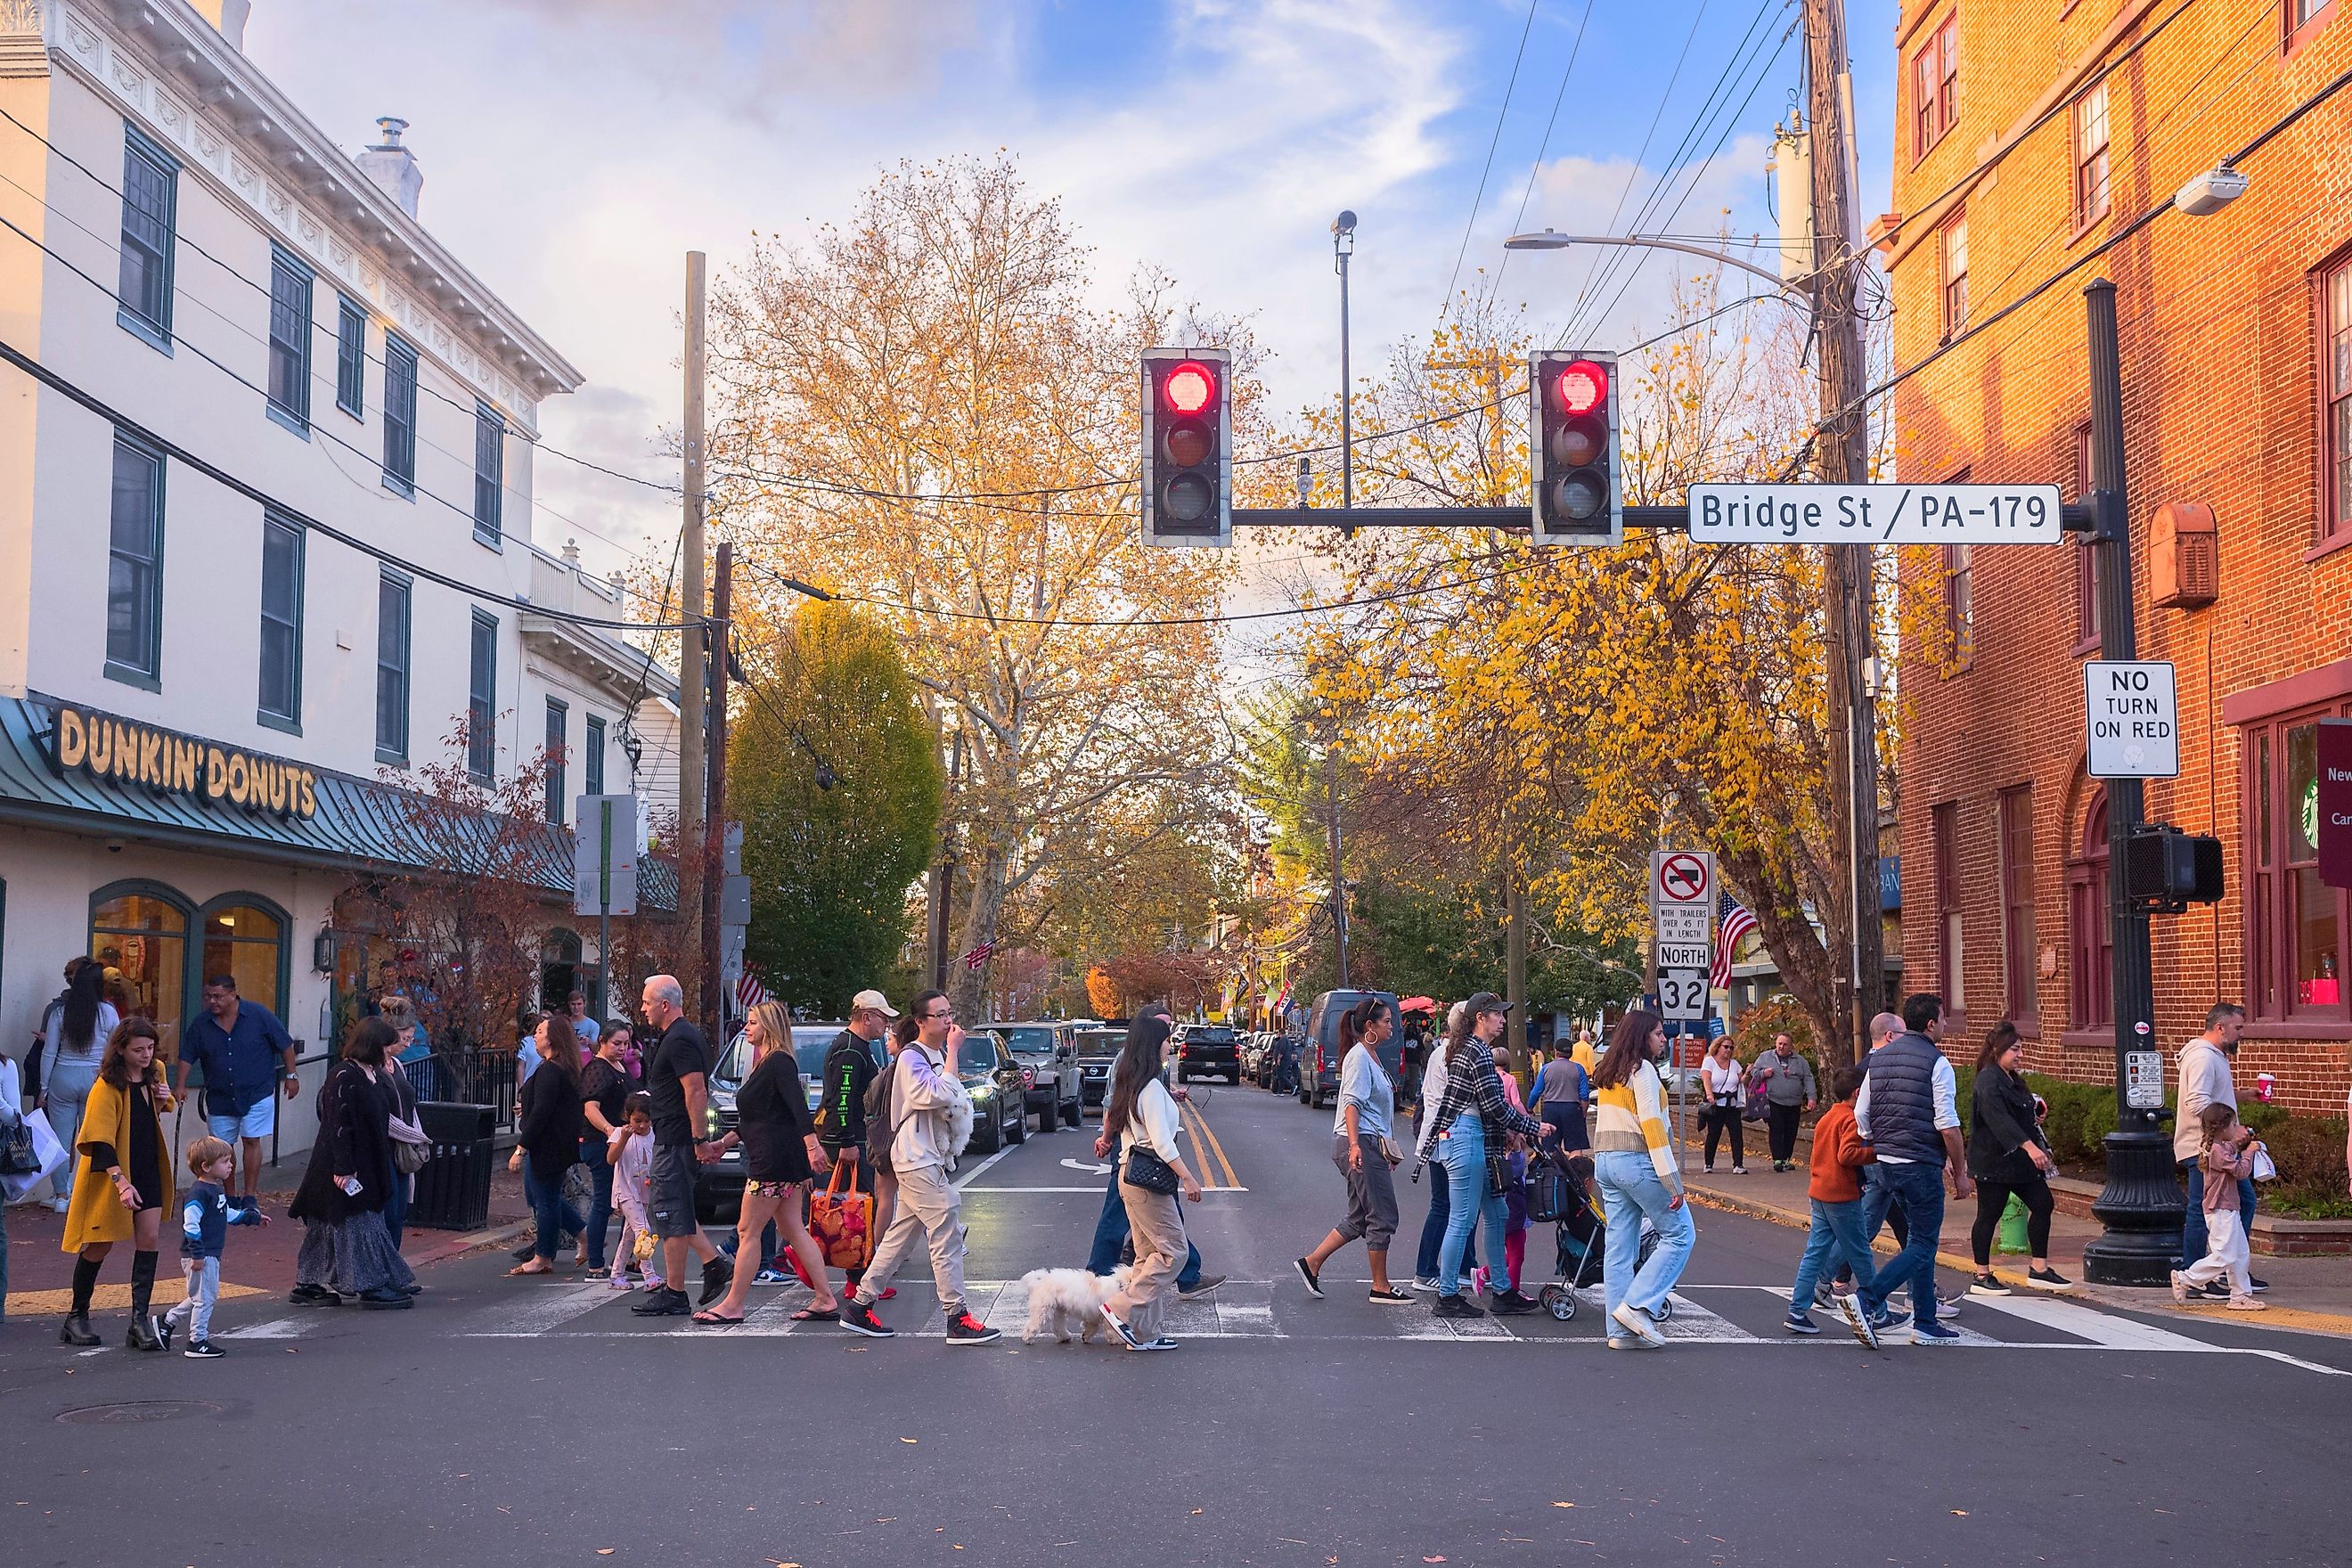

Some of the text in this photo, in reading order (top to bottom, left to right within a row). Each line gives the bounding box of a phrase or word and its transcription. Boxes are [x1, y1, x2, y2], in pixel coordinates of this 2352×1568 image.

[1703, 494, 1821, 535] Bridge
[1839, 495, 1871, 527] St
[1922, 495, 2046, 527] PA-179
[2111, 671, 2149, 691] NO
[2106, 698, 2158, 715] TURN
[2095, 722, 2170, 738] ON RED
[60, 708, 316, 818] DUNKIN' DONUTS
[2328, 767, 2352, 781] New
[1661, 909, 1707, 918] WITH TRAILERS
[1662, 919, 1704, 927] OVER 45 FT
[1666, 929, 1701, 938] IN LENGTH
[1661, 947, 1706, 964] NORTH
[1664, 981, 1703, 1009] 32
